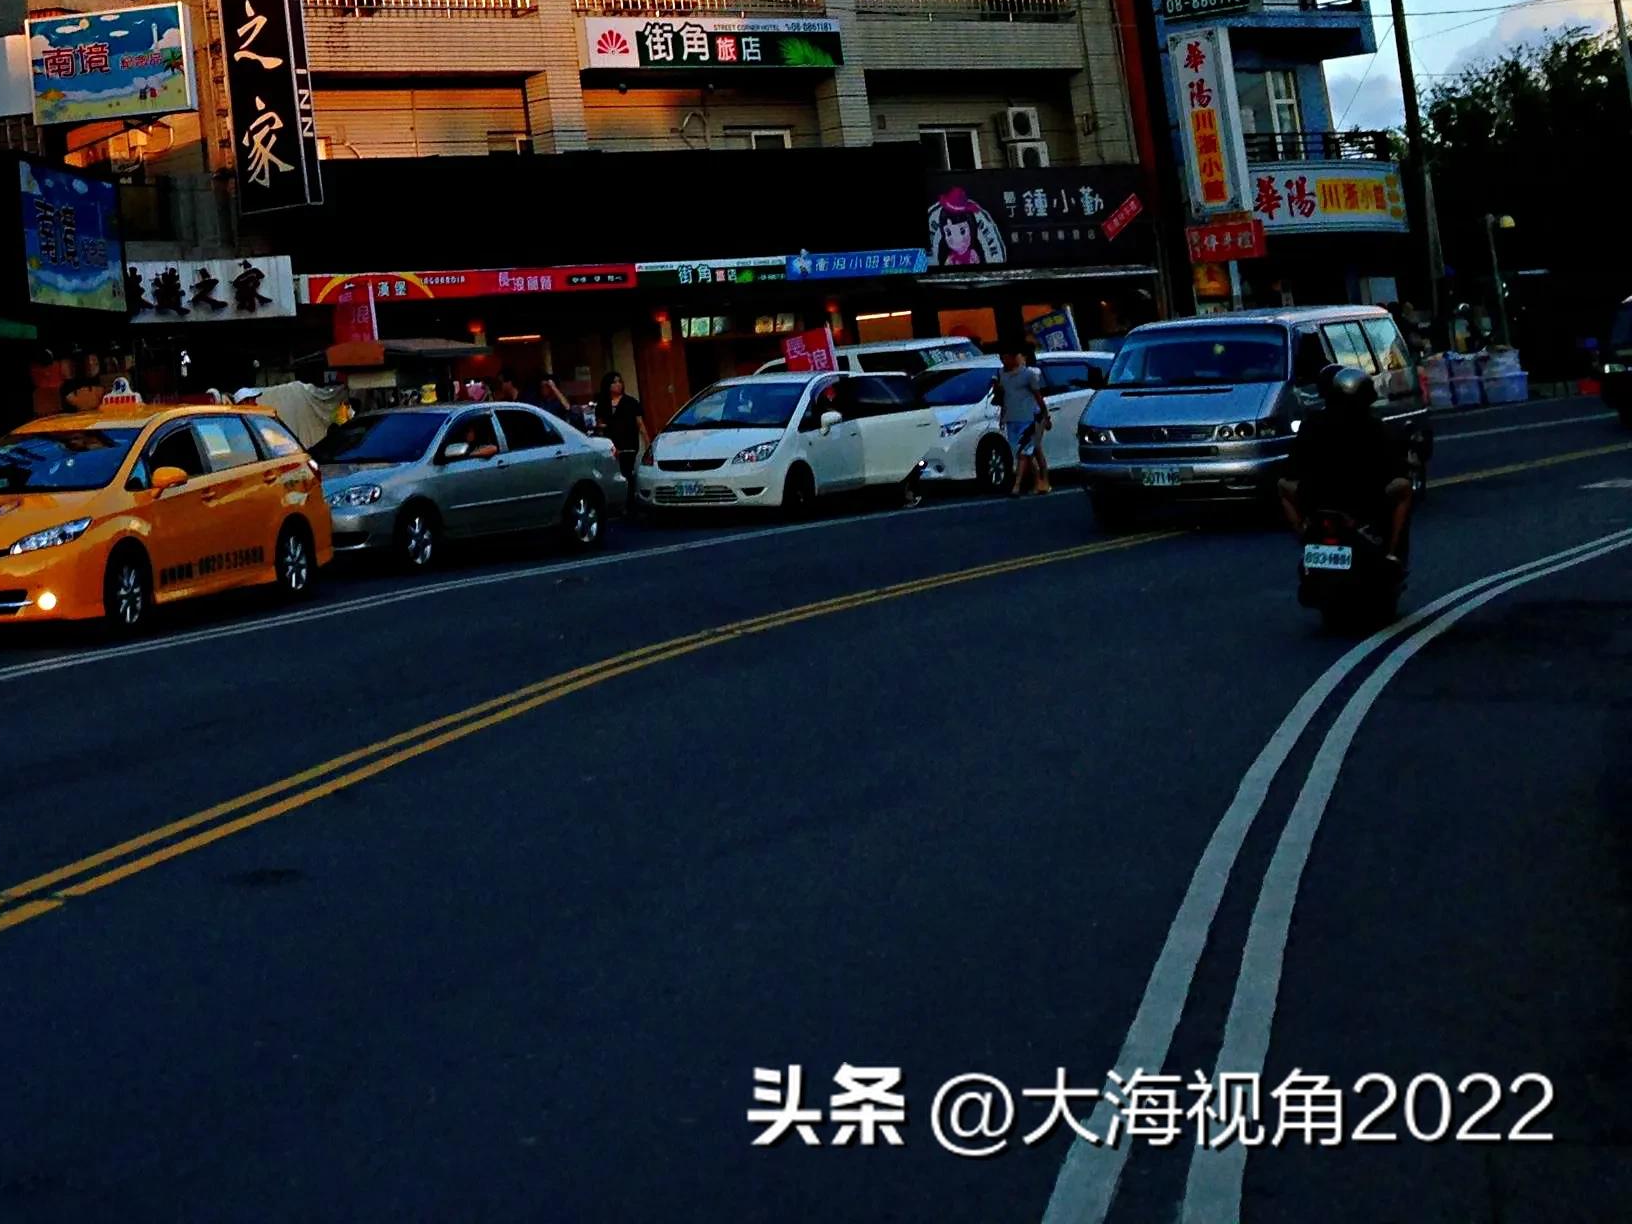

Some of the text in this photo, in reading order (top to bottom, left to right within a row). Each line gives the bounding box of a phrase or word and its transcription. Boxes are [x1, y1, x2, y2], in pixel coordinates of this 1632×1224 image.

[643, 22, 763, 63] 街角旅店
[295, 68, 314, 139] INN
